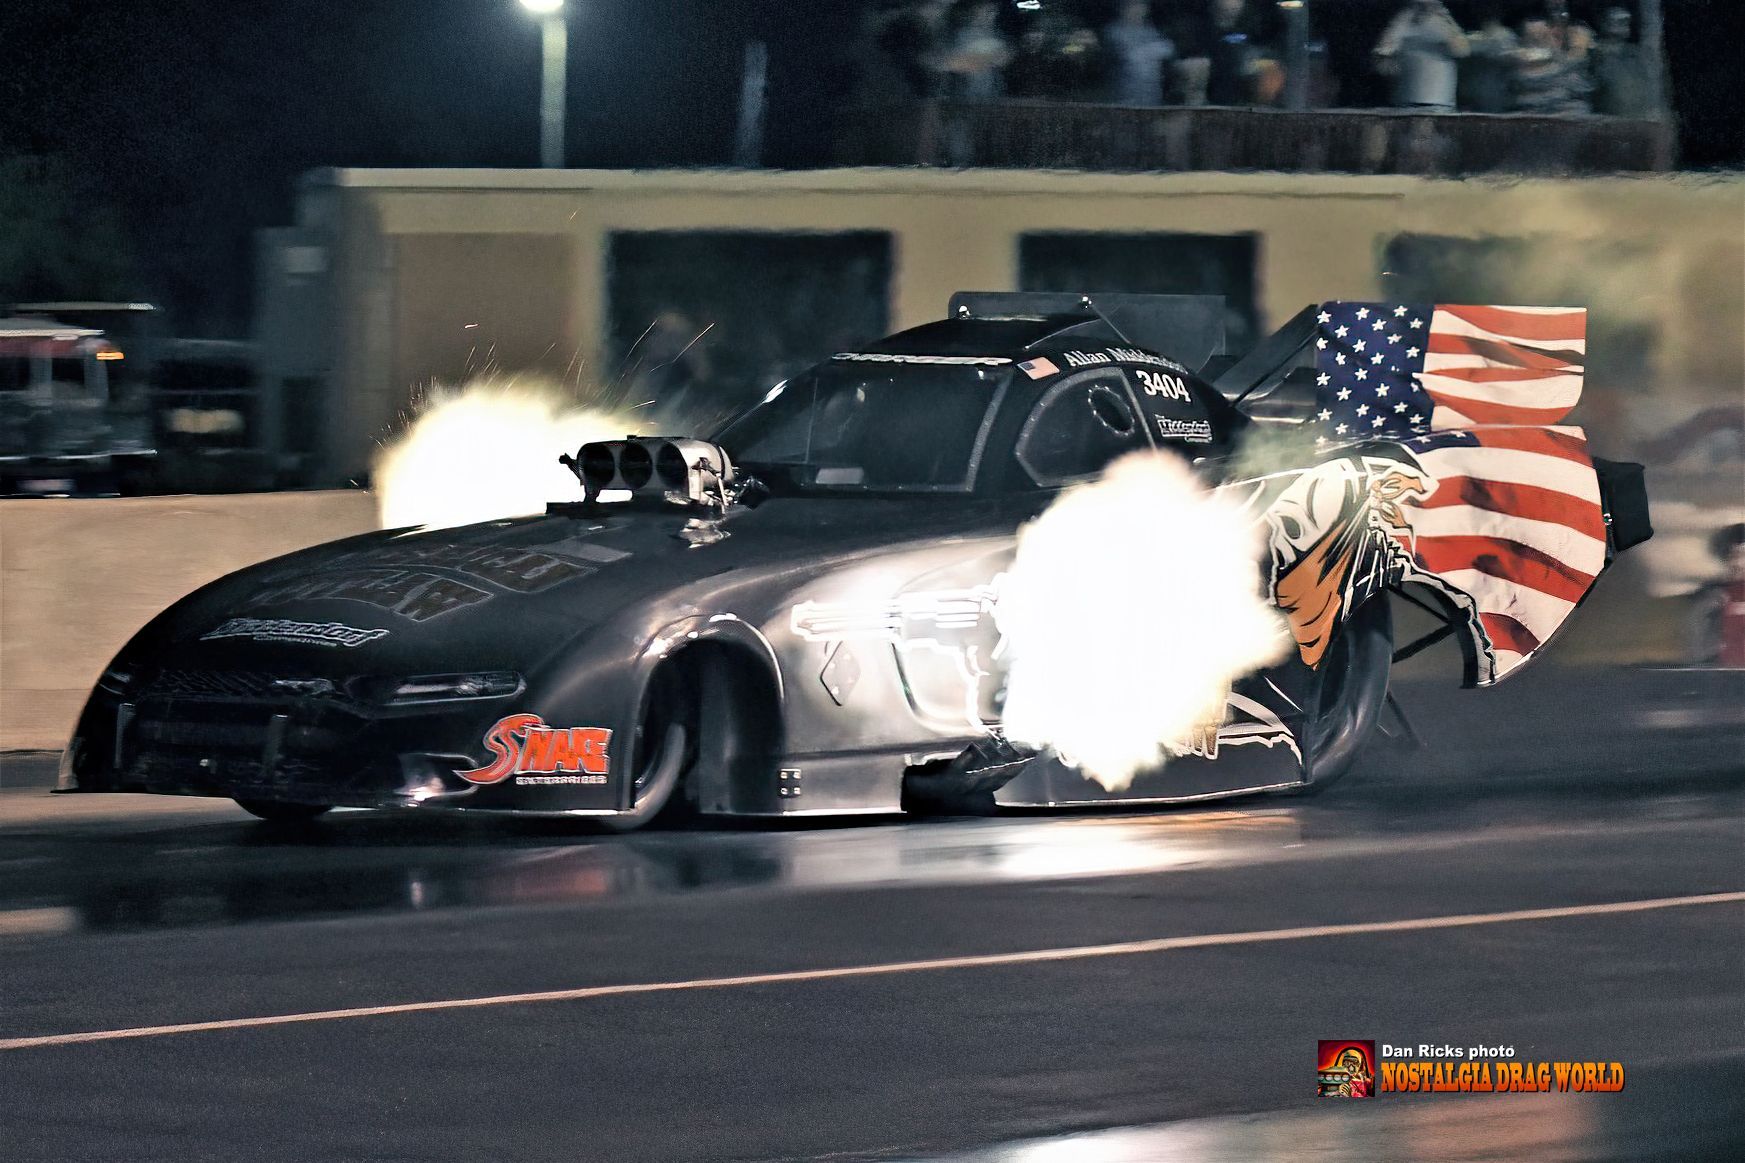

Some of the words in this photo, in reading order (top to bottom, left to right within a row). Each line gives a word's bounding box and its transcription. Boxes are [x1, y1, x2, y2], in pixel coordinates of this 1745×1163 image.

[1063, 351, 1112, 367] Allan
[1136, 370, 1192, 403] 3404
[454, 713, 614, 786] SNAKE
